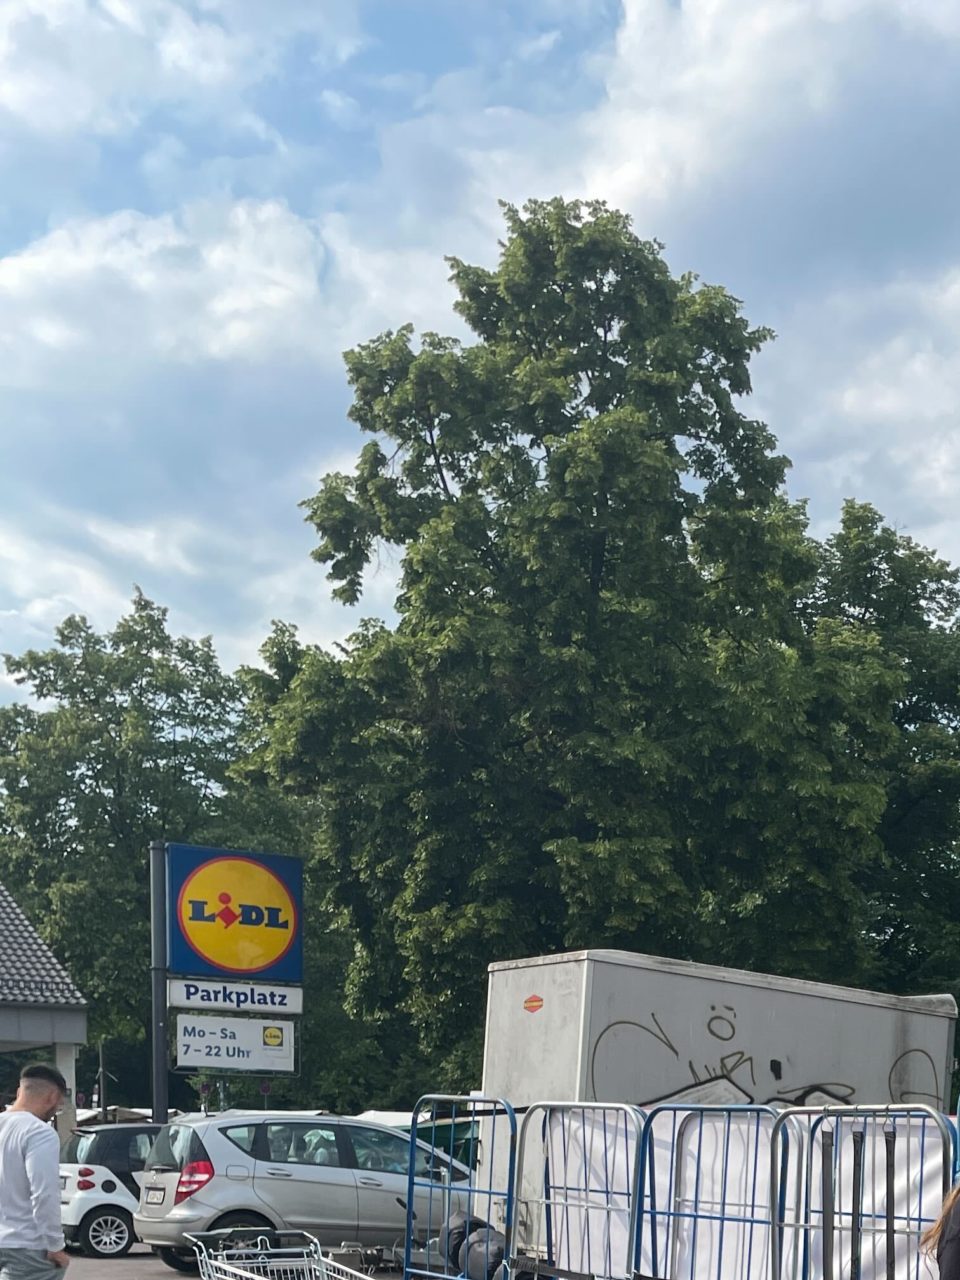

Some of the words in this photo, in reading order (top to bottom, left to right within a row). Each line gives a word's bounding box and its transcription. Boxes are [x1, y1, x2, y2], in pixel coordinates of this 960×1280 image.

[184, 983, 288, 1008] Parkplatz
[183, 1026, 206, 1038] Mo
[220, 1027, 237, 1040] Sa
[182, 1044, 191, 1056] 7
[205, 1045, 222, 1058] 22
[226, 1046, 252, 1059] Uhr
